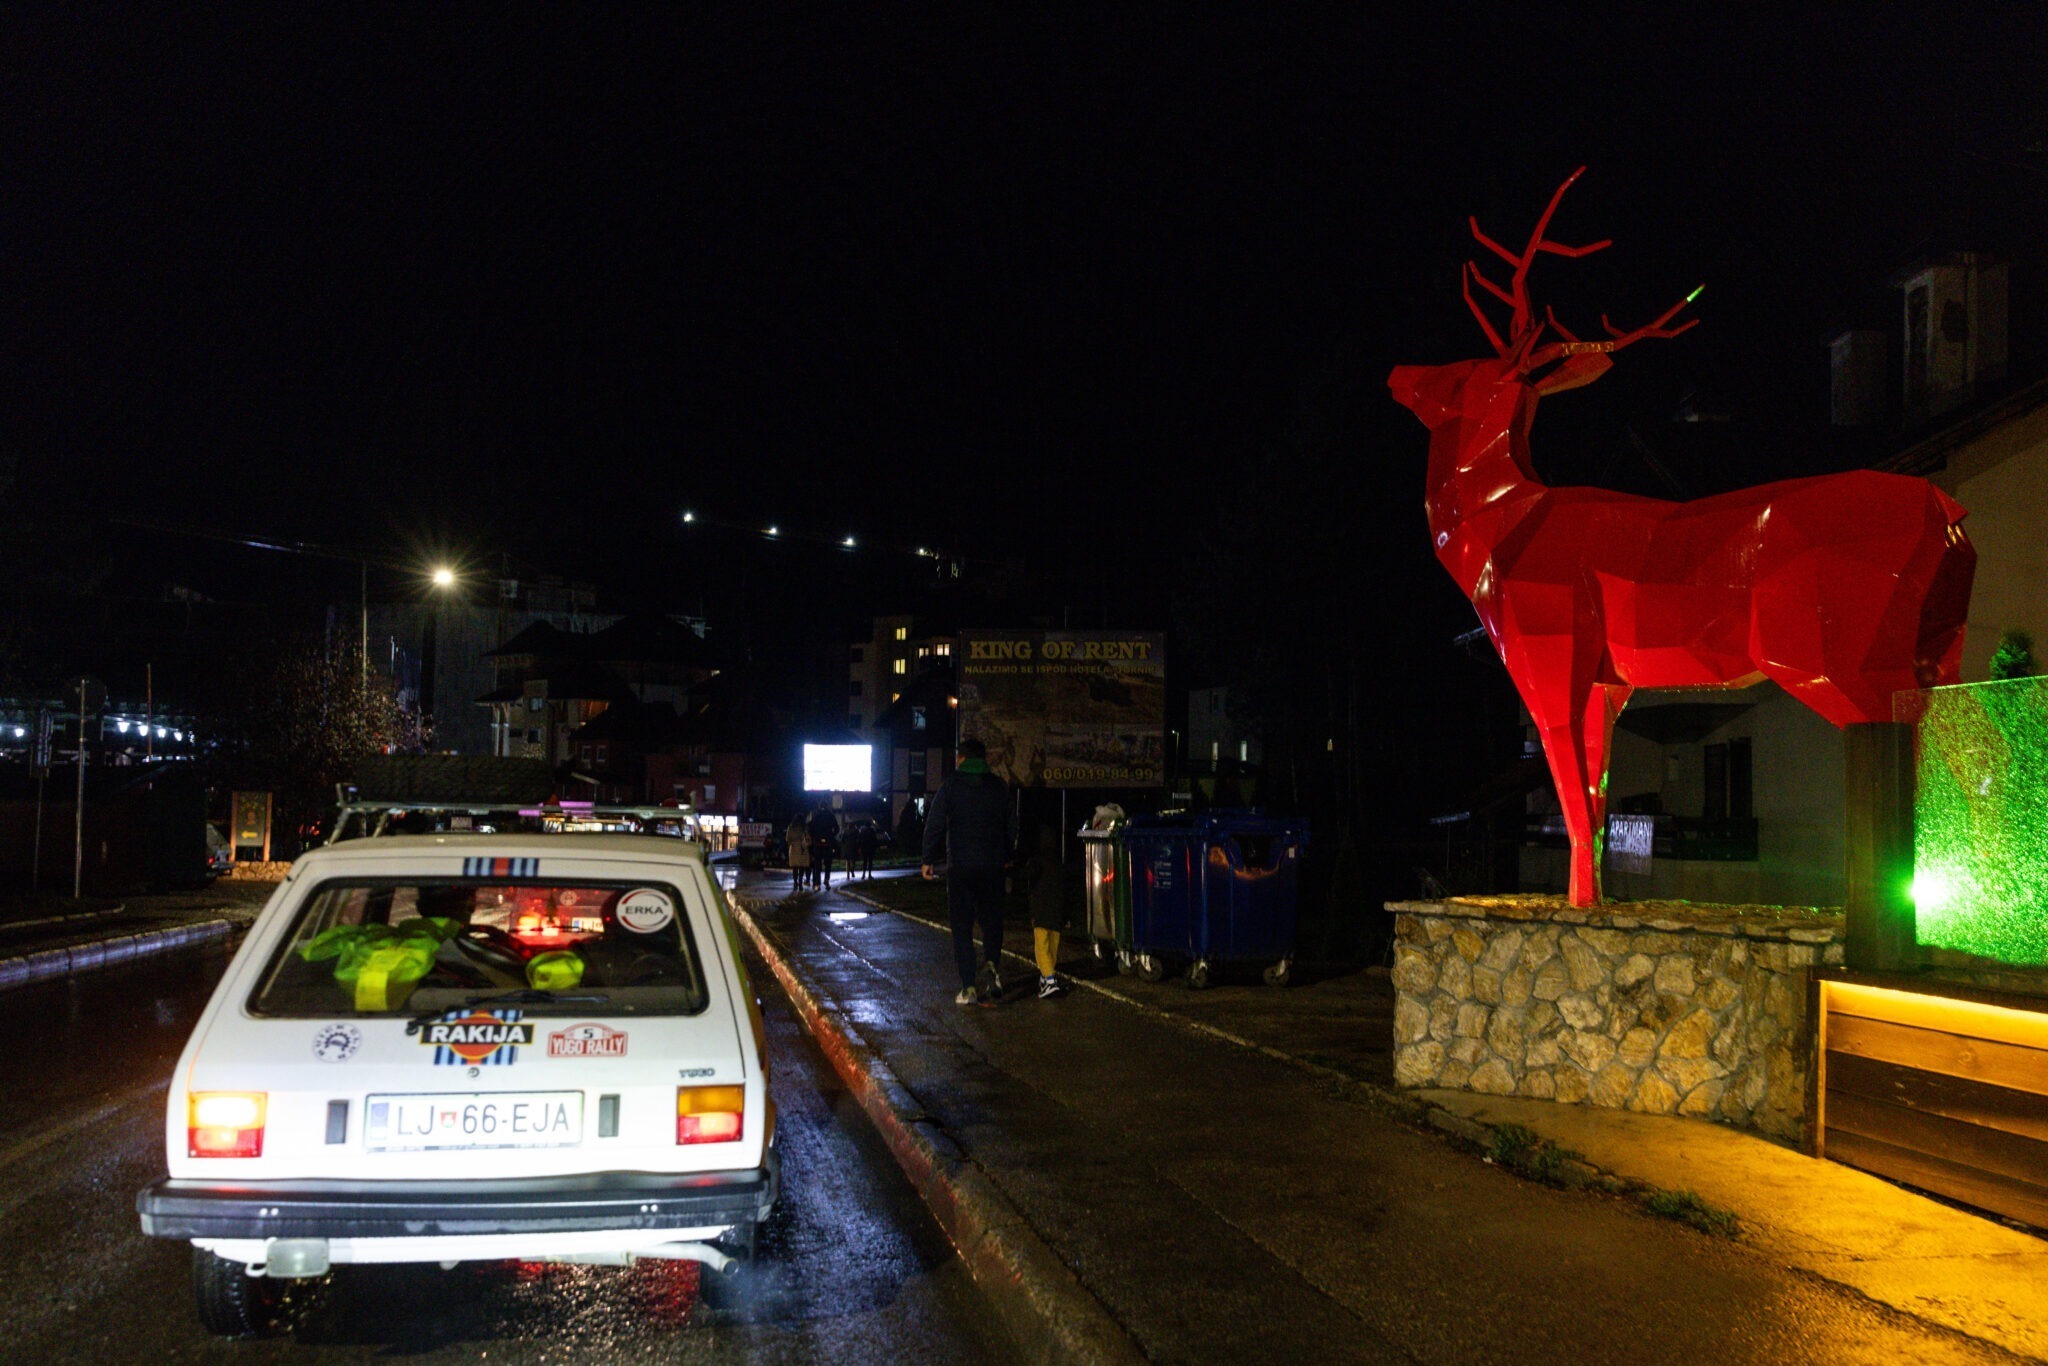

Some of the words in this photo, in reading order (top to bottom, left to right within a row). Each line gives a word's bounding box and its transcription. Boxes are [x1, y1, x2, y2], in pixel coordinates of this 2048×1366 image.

[969, 641, 1033, 660] KING
[1041, 641, 1077, 660] OF
[1083, 641, 1151, 660] RENT
[625, 906, 664, 915] ERKA
[430, 1025, 525, 1043] RAKIJA
[583, 1028, 595, 1039] 5
[552, 1037, 584, 1055] YUGO
[587, 1036, 626, 1055] RALLY
[397, 1105, 435, 1136] LJ
[462, 1102, 569, 1134] 66-EJA
